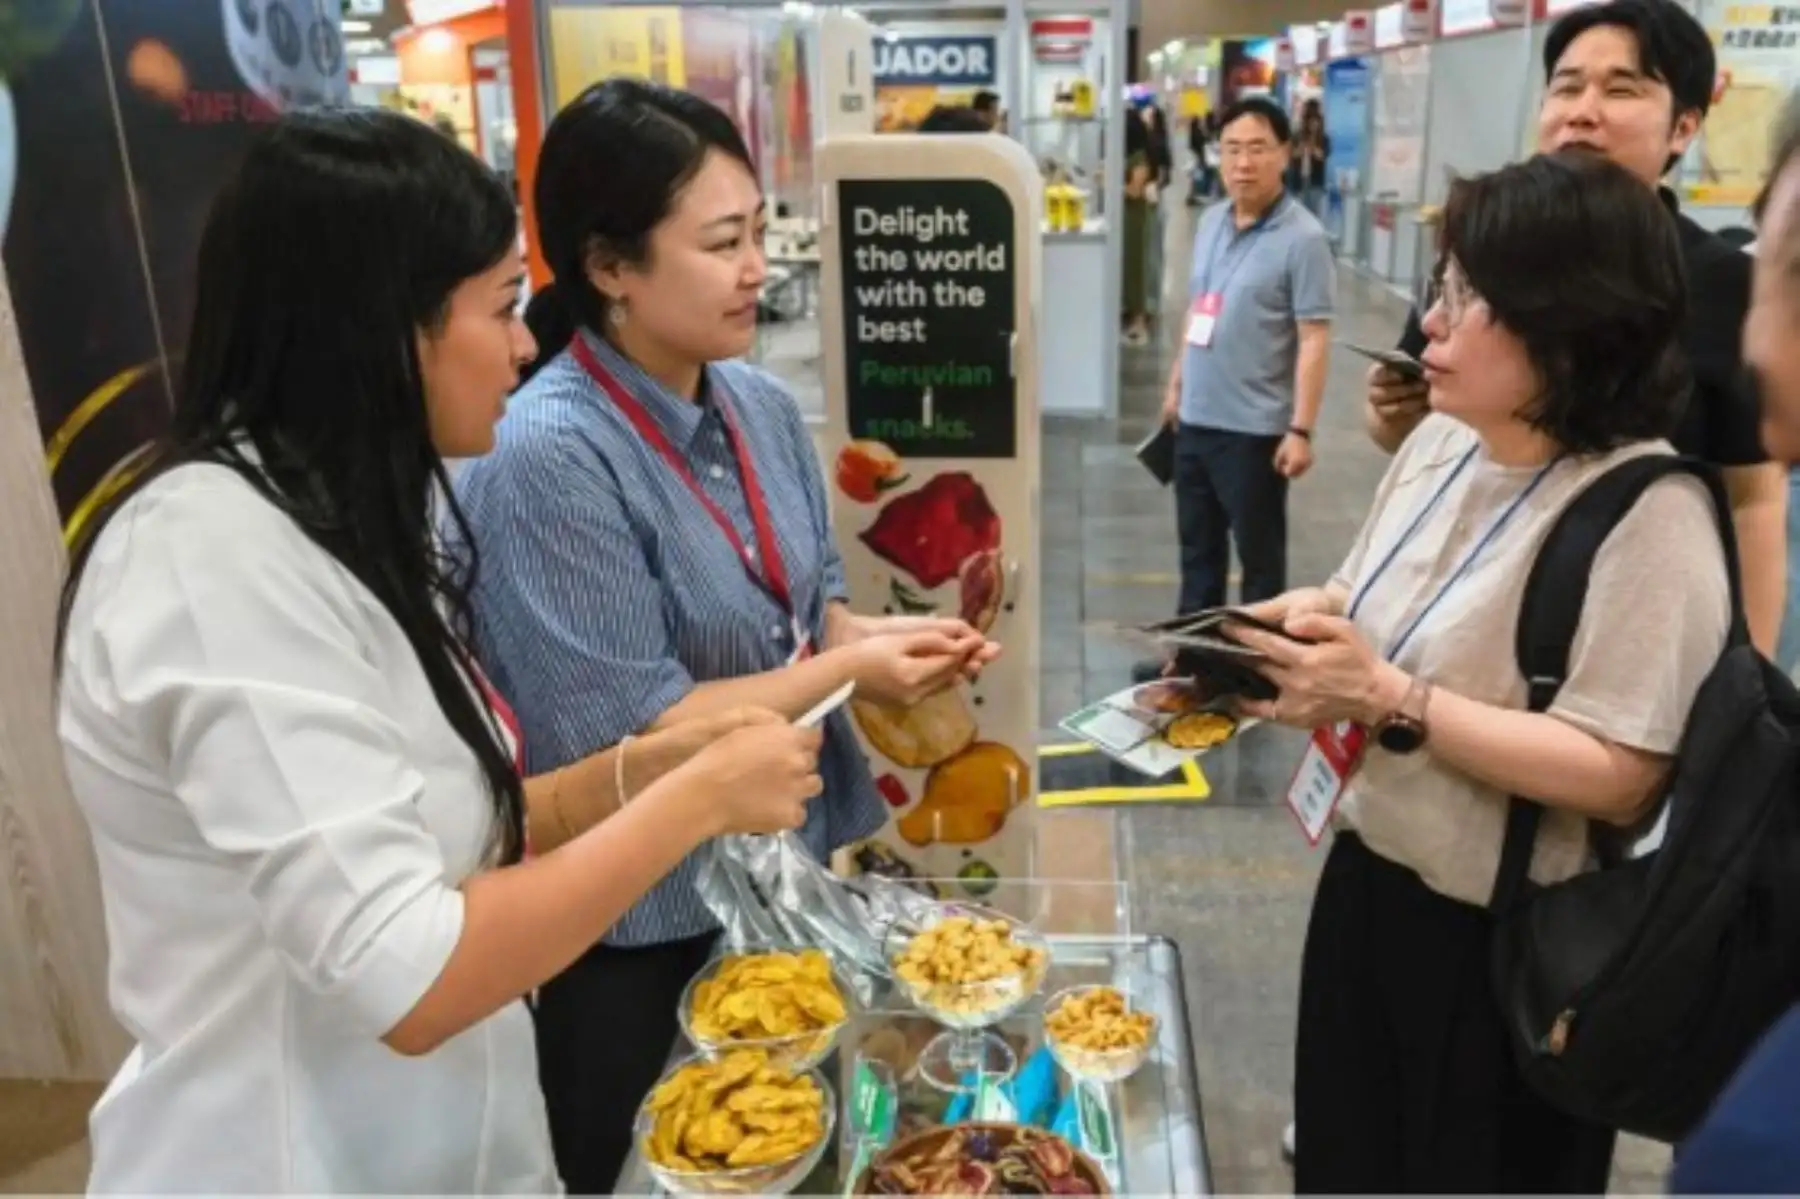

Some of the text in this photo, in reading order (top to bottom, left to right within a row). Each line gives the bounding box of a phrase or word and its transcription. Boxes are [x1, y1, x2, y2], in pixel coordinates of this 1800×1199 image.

[853, 207, 970, 243] Delight
[854, 243, 1006, 272] the world
[856, 279, 986, 307] with the
[857, 315, 927, 342] best
[859, 359, 993, 387] Peruvian
